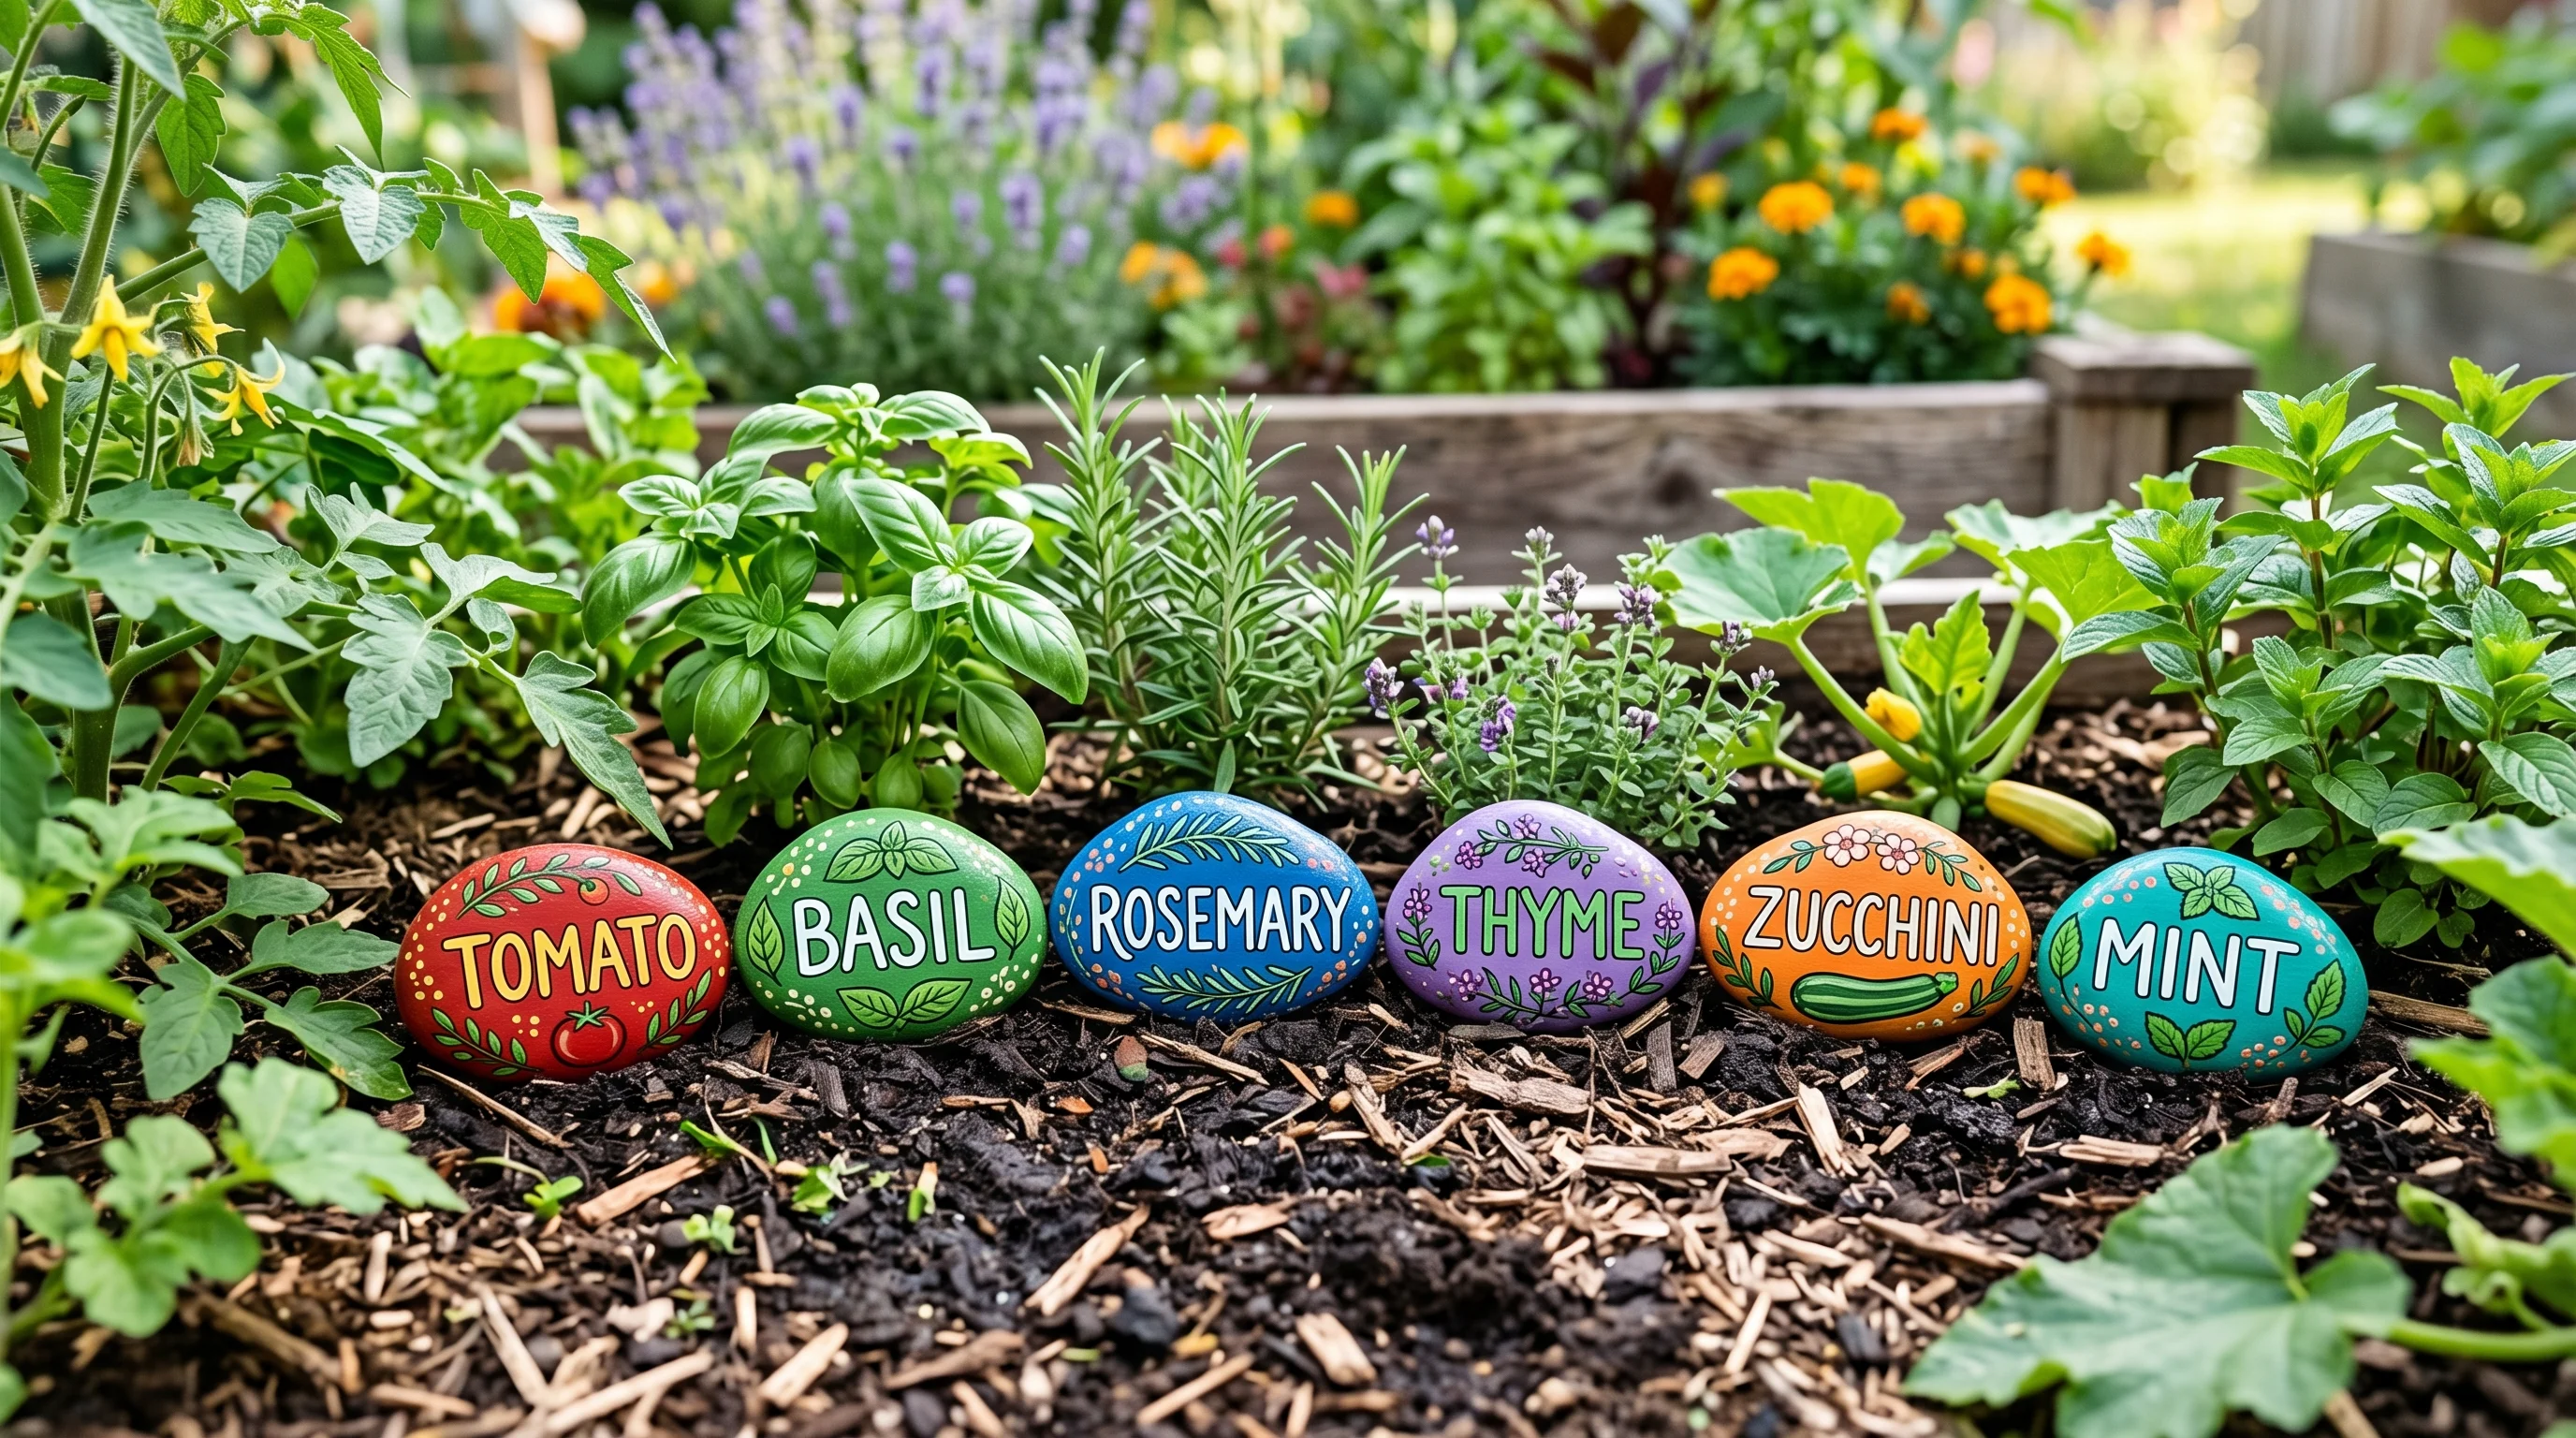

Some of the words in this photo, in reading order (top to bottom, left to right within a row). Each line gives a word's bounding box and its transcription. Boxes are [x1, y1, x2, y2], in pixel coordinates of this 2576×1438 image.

[443, 913, 697, 1010] TOMATO
[792, 888, 997, 977] BASIL
[1090, 885, 1353, 961] ROSEMARY
[1440, 885, 1647, 961] THYME
[1742, 885, 1999, 966] ZUCCHINI
[2091, 917, 2301, 1016] MINT
